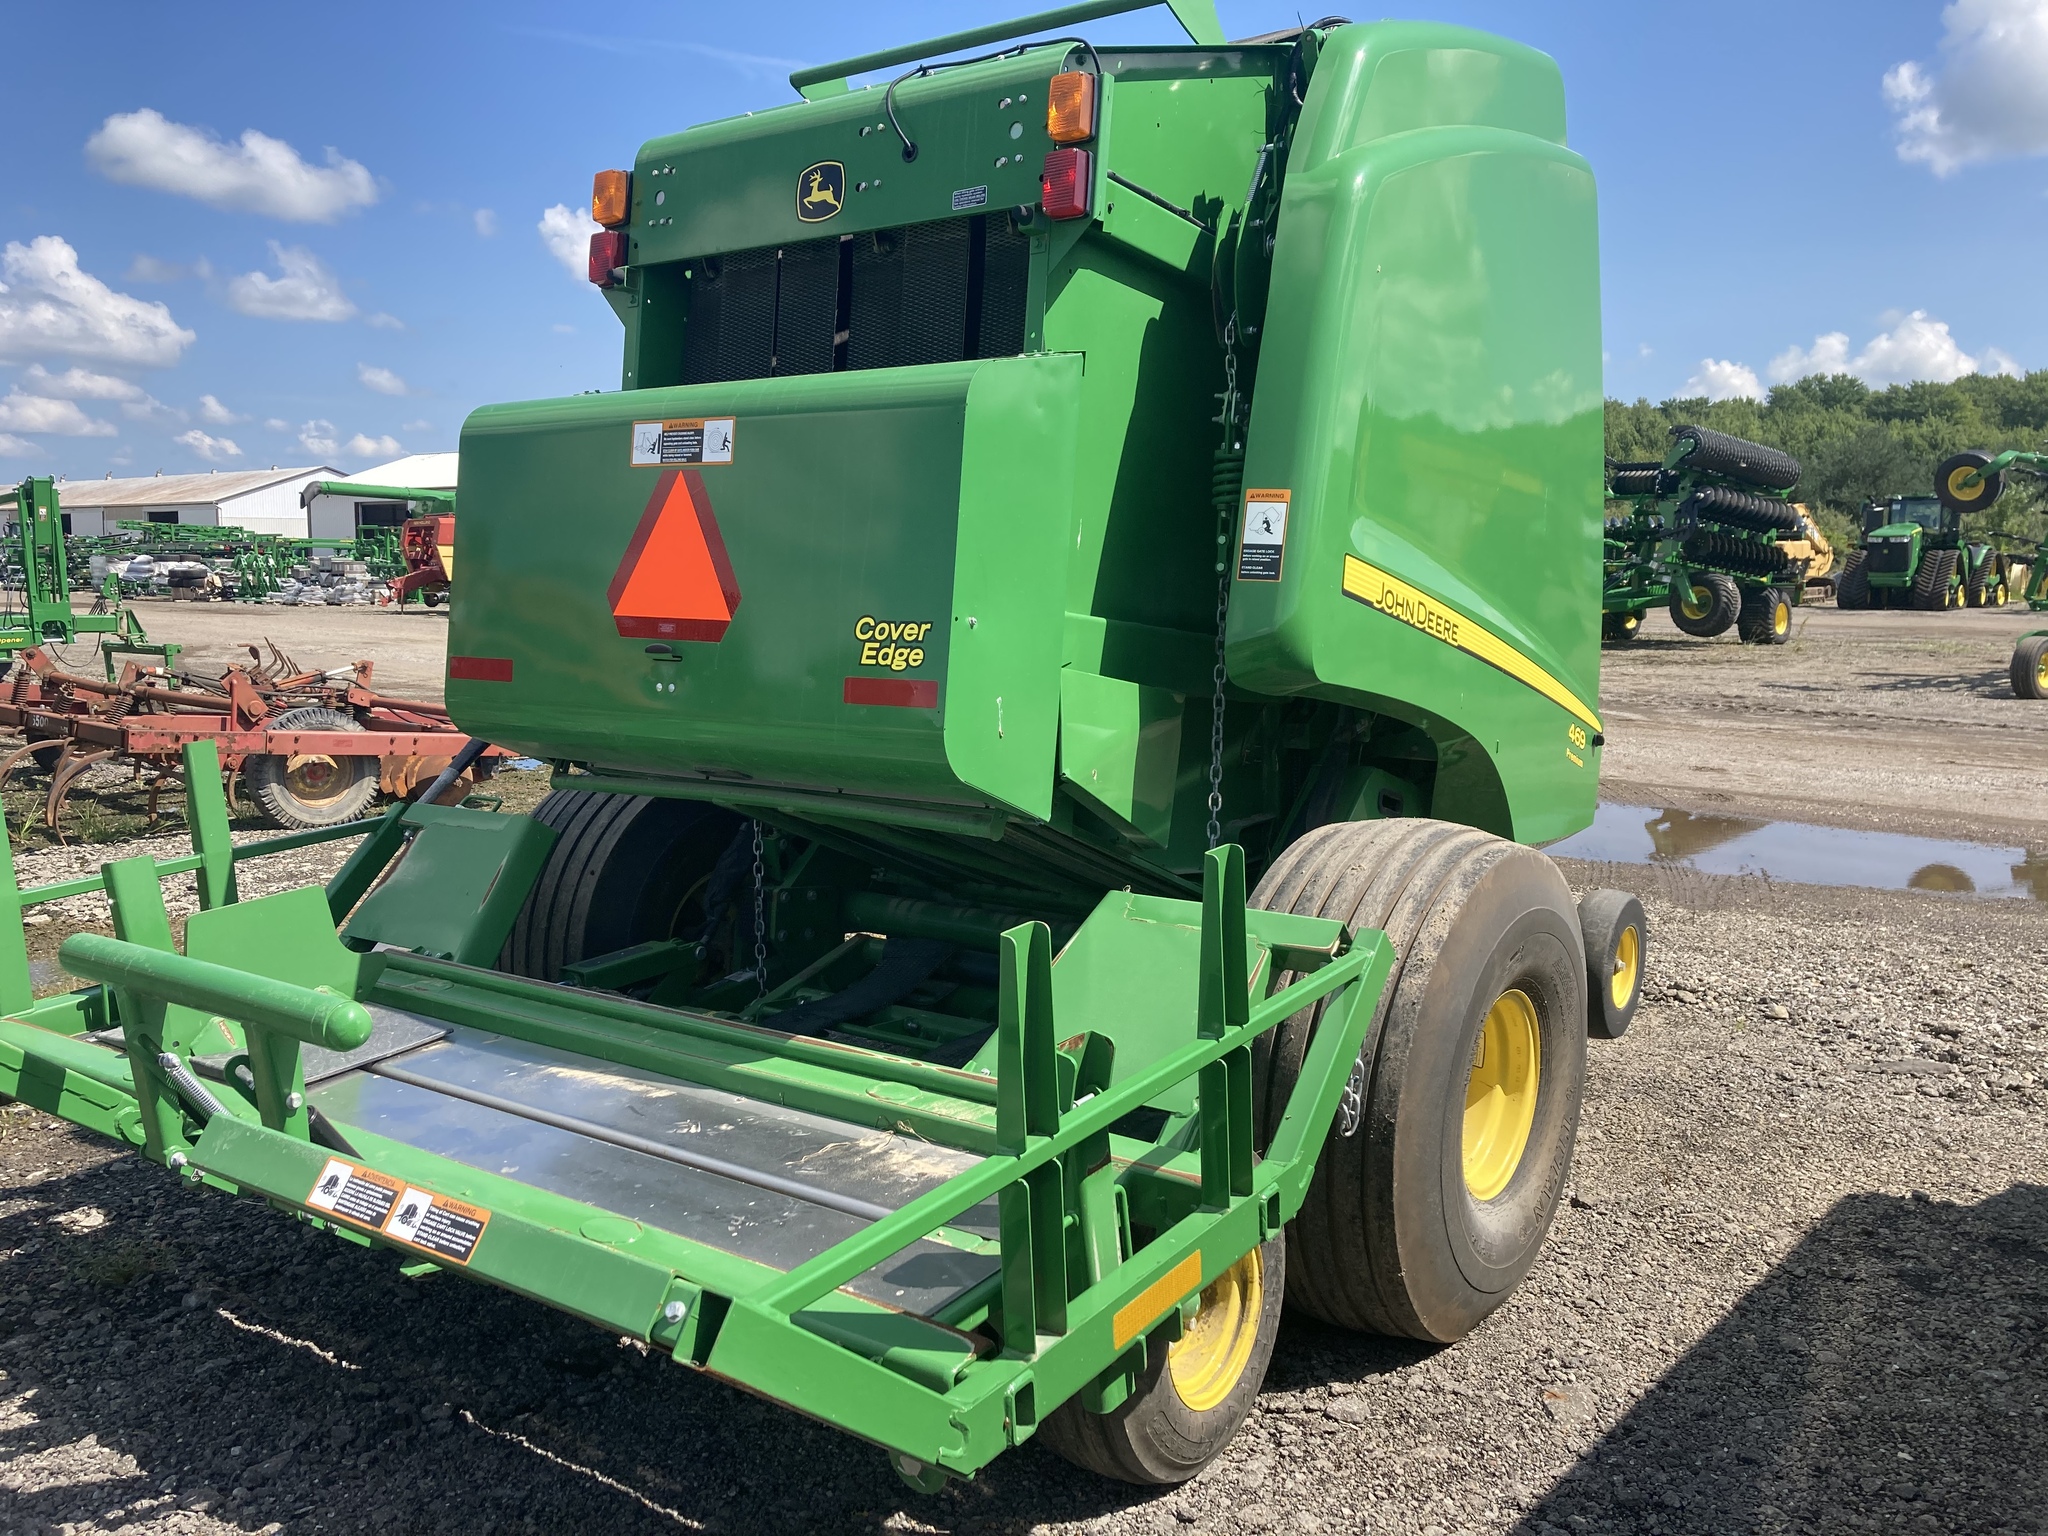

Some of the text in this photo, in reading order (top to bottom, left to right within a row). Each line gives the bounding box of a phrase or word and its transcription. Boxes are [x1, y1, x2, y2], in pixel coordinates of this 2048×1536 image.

[1376, 582, 1459, 643] JOHN DEERE
[0, 637, 24, 645] pener
[855, 616, 932, 642] Cover
[860, 642, 924, 671] Edge
[1568, 722, 1586, 750] 469
[367, 1171, 395, 1187] ADVERTENCIA
[448, 1201, 476, 1217] WARNING
